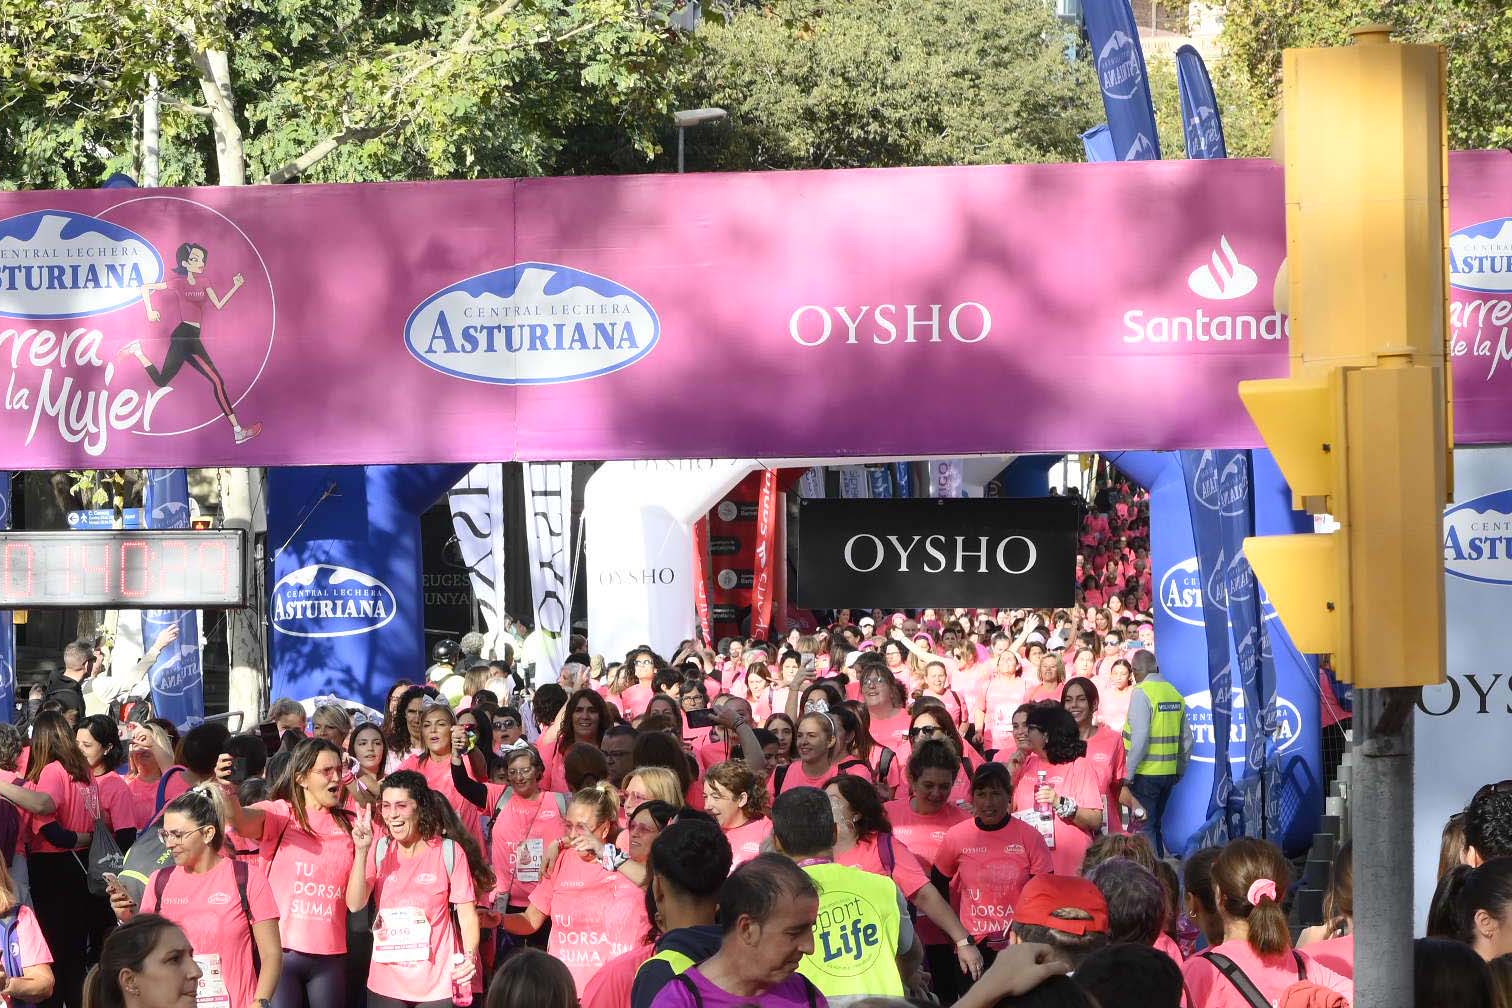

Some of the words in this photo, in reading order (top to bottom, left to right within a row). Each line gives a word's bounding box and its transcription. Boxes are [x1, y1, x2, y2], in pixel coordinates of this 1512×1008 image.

[66, 247, 140, 259] LECHERA
[464, 306, 542, 318] CENTRAL
[550, 304, 633, 316] LECHERA
[424, 310, 640, 354] ASTURIANA
[789, 301, 992, 346] OYSHO
[1123, 309, 1289, 343] Santand
[1474, 330, 1491, 356] la
[5, 371, 30, 411] la
[25, 361, 174, 457] Mujer
[844, 532, 1038, 576] OYSHO
[599, 567, 675, 585] OYSHO
[287, 590, 328, 598] CENTRAL
[333, 588, 382, 598] LECHERA
[274, 593, 388, 622] ASTURIANA
[295, 862, 314, 877] TU
[294, 881, 342, 899] DORSA
[291, 899, 333, 917] SUMA
[812, 897, 863, 933] port
[555, 915, 571, 928] TU
[559, 931, 609, 945] DORSA
[819, 919, 879, 963] Life
[560, 948, 602, 962] SUMA
